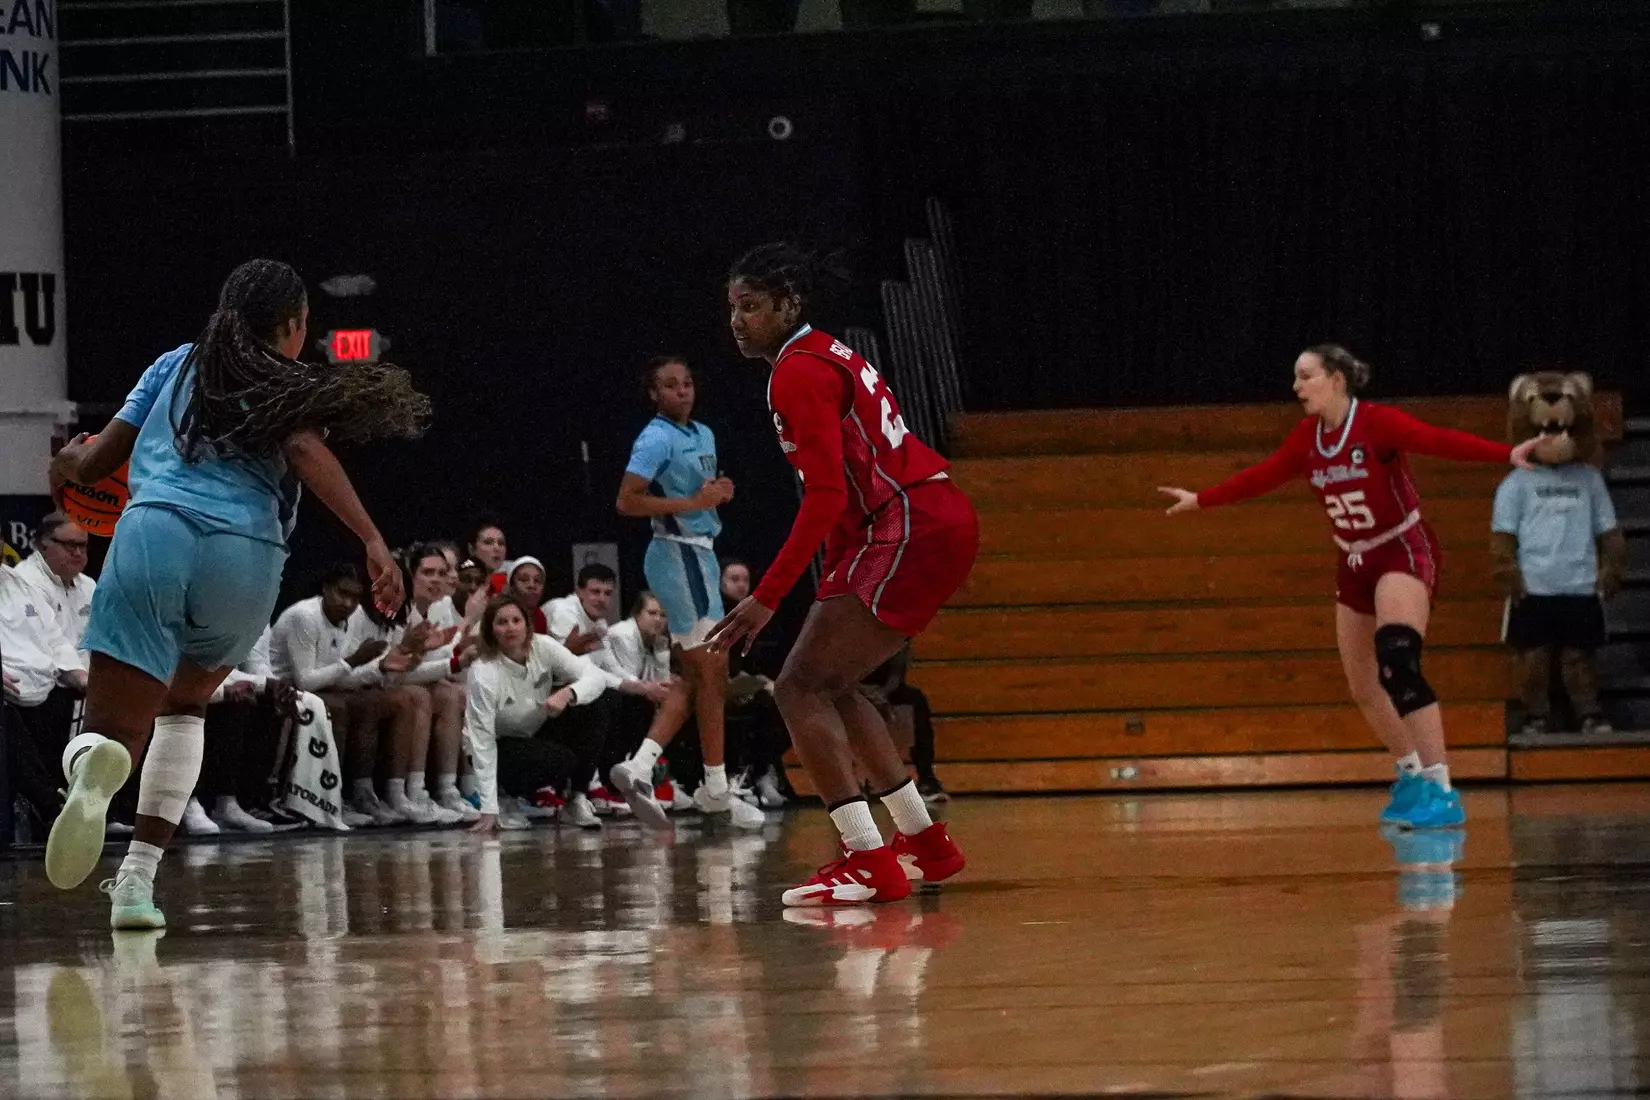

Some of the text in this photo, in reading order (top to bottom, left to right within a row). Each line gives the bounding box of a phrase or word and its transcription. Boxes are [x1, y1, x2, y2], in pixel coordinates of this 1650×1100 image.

[0, 0, 54, 39] AN
[0, 50, 51, 95] NK
[335, 330, 372, 360] EXIT
[1324, 490, 1377, 531] 25
